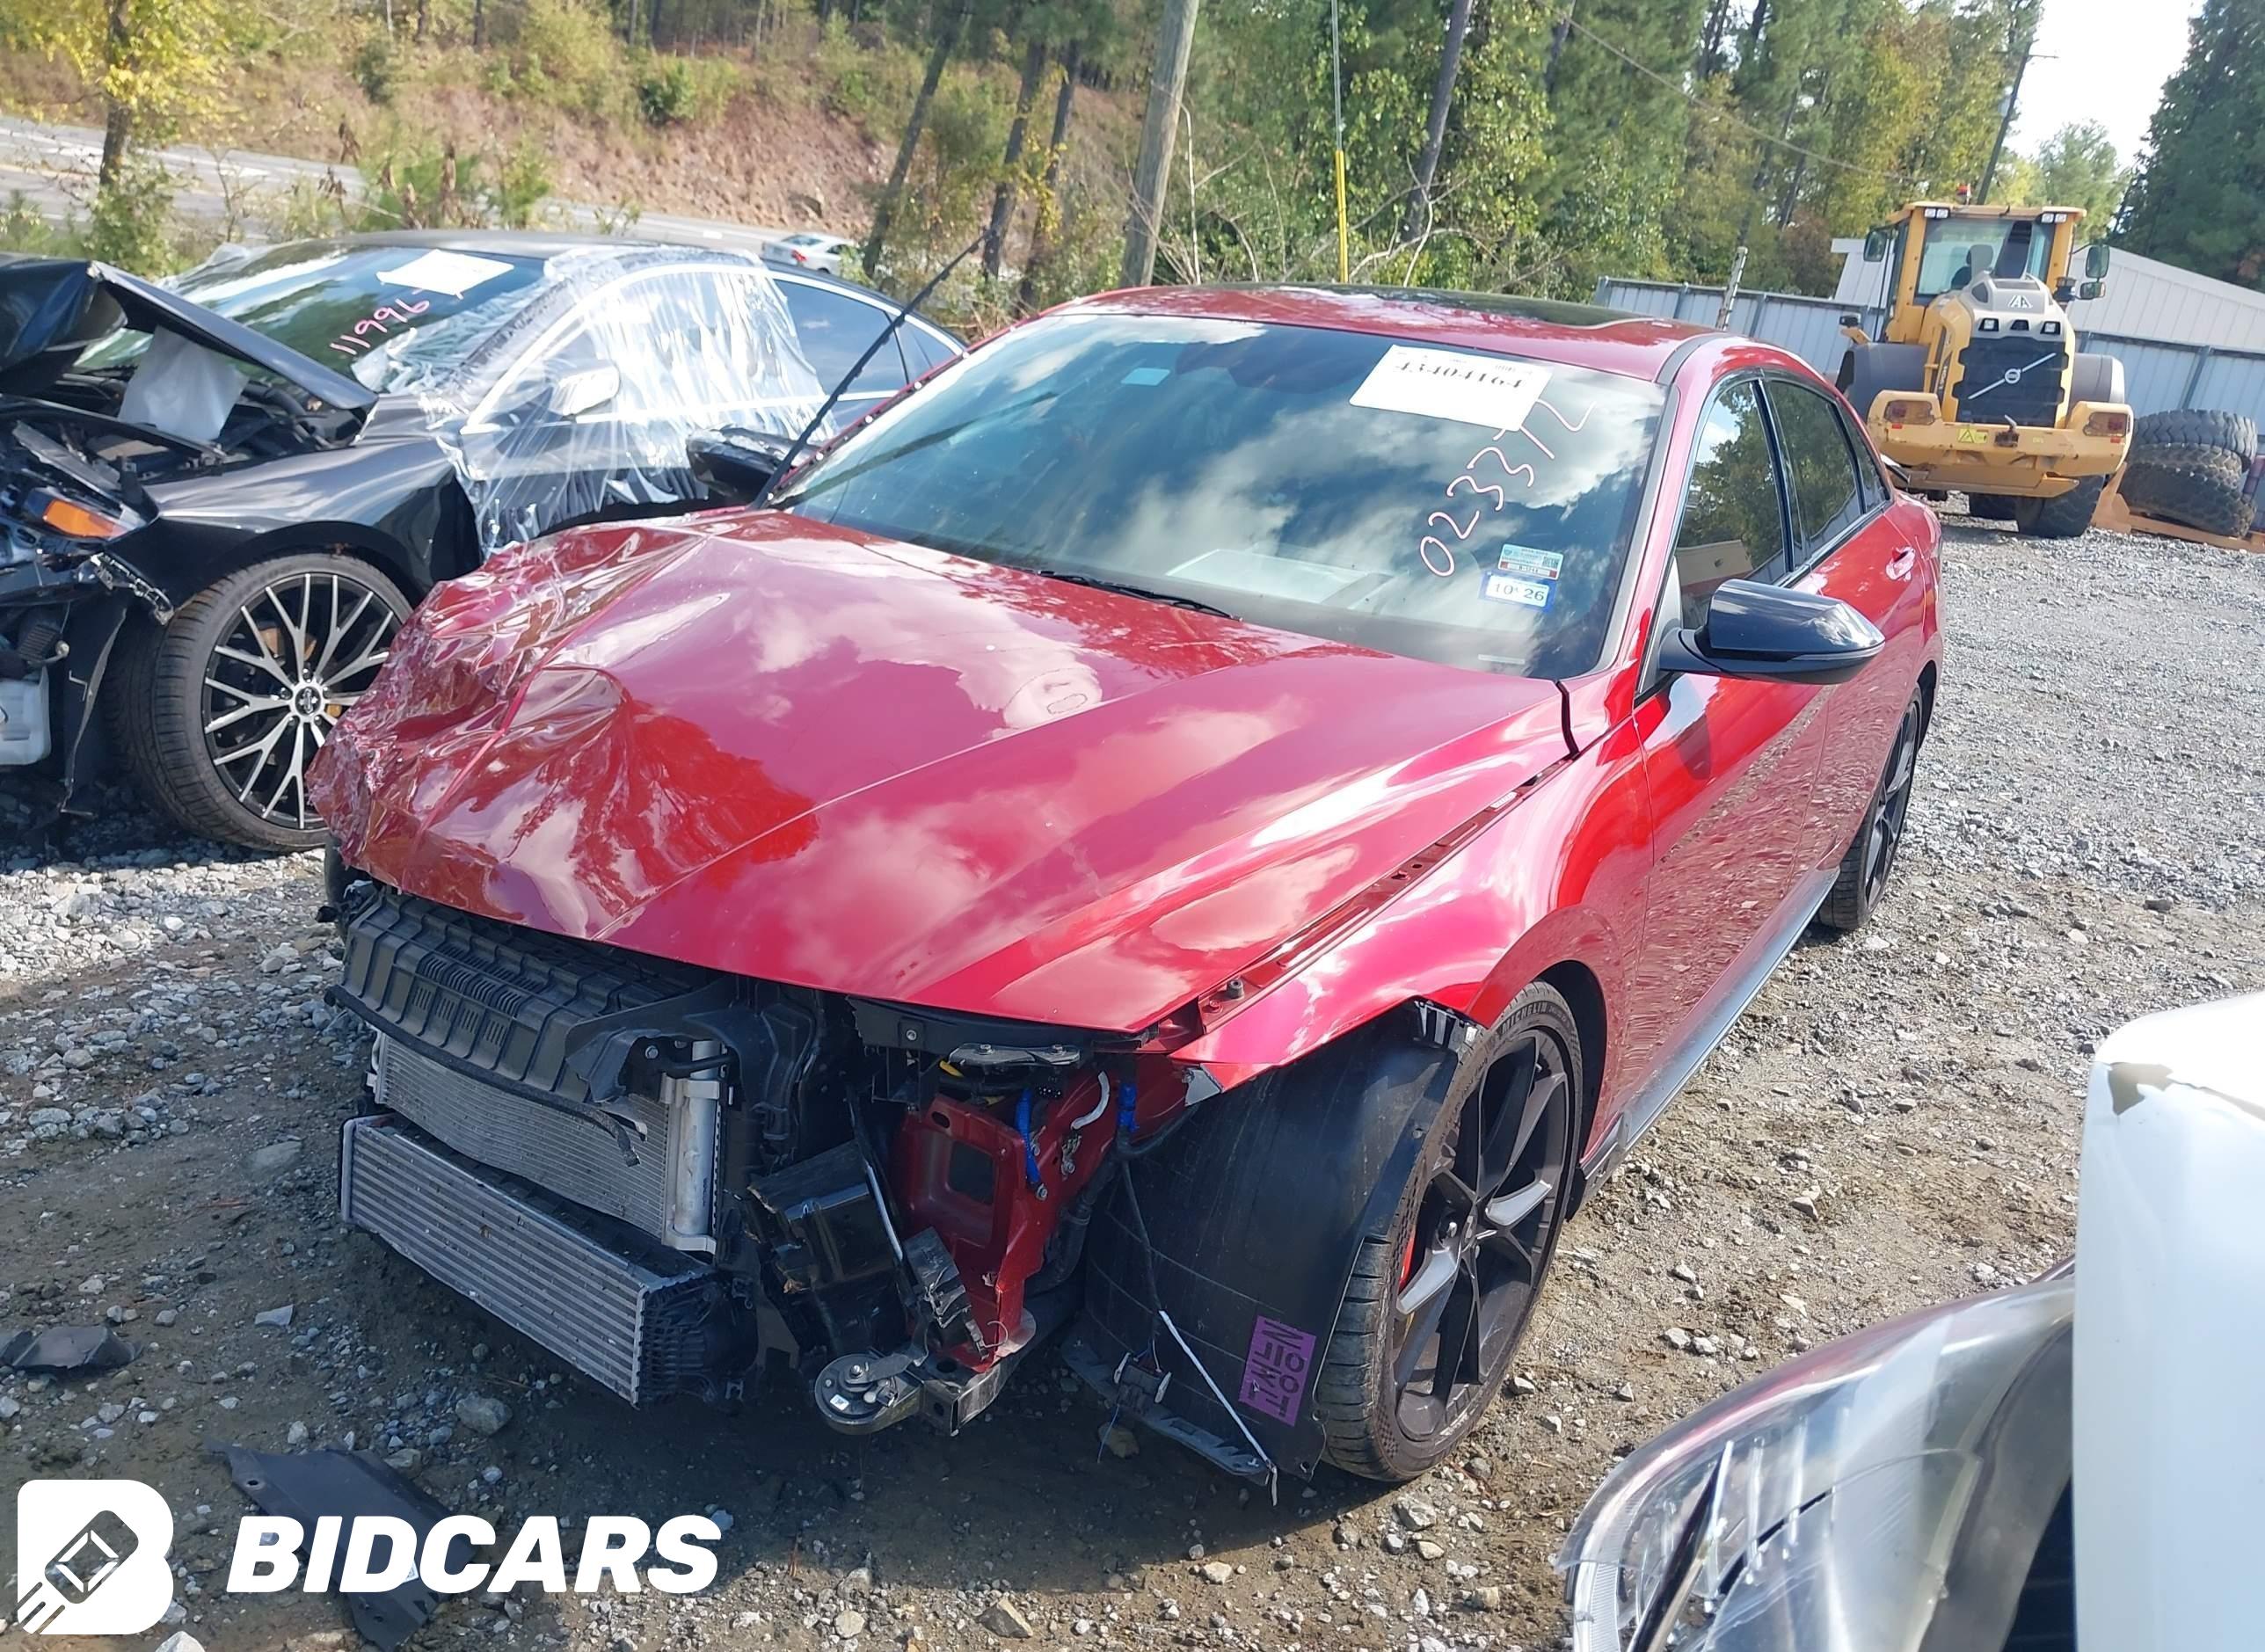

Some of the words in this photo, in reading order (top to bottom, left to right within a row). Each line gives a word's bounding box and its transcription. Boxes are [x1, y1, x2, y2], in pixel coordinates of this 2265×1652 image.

[330, 288, 463, 355] 11996
[1524, 588, 1545, 601] 26
[1501, 1001, 1548, 1035] MICHELIN
